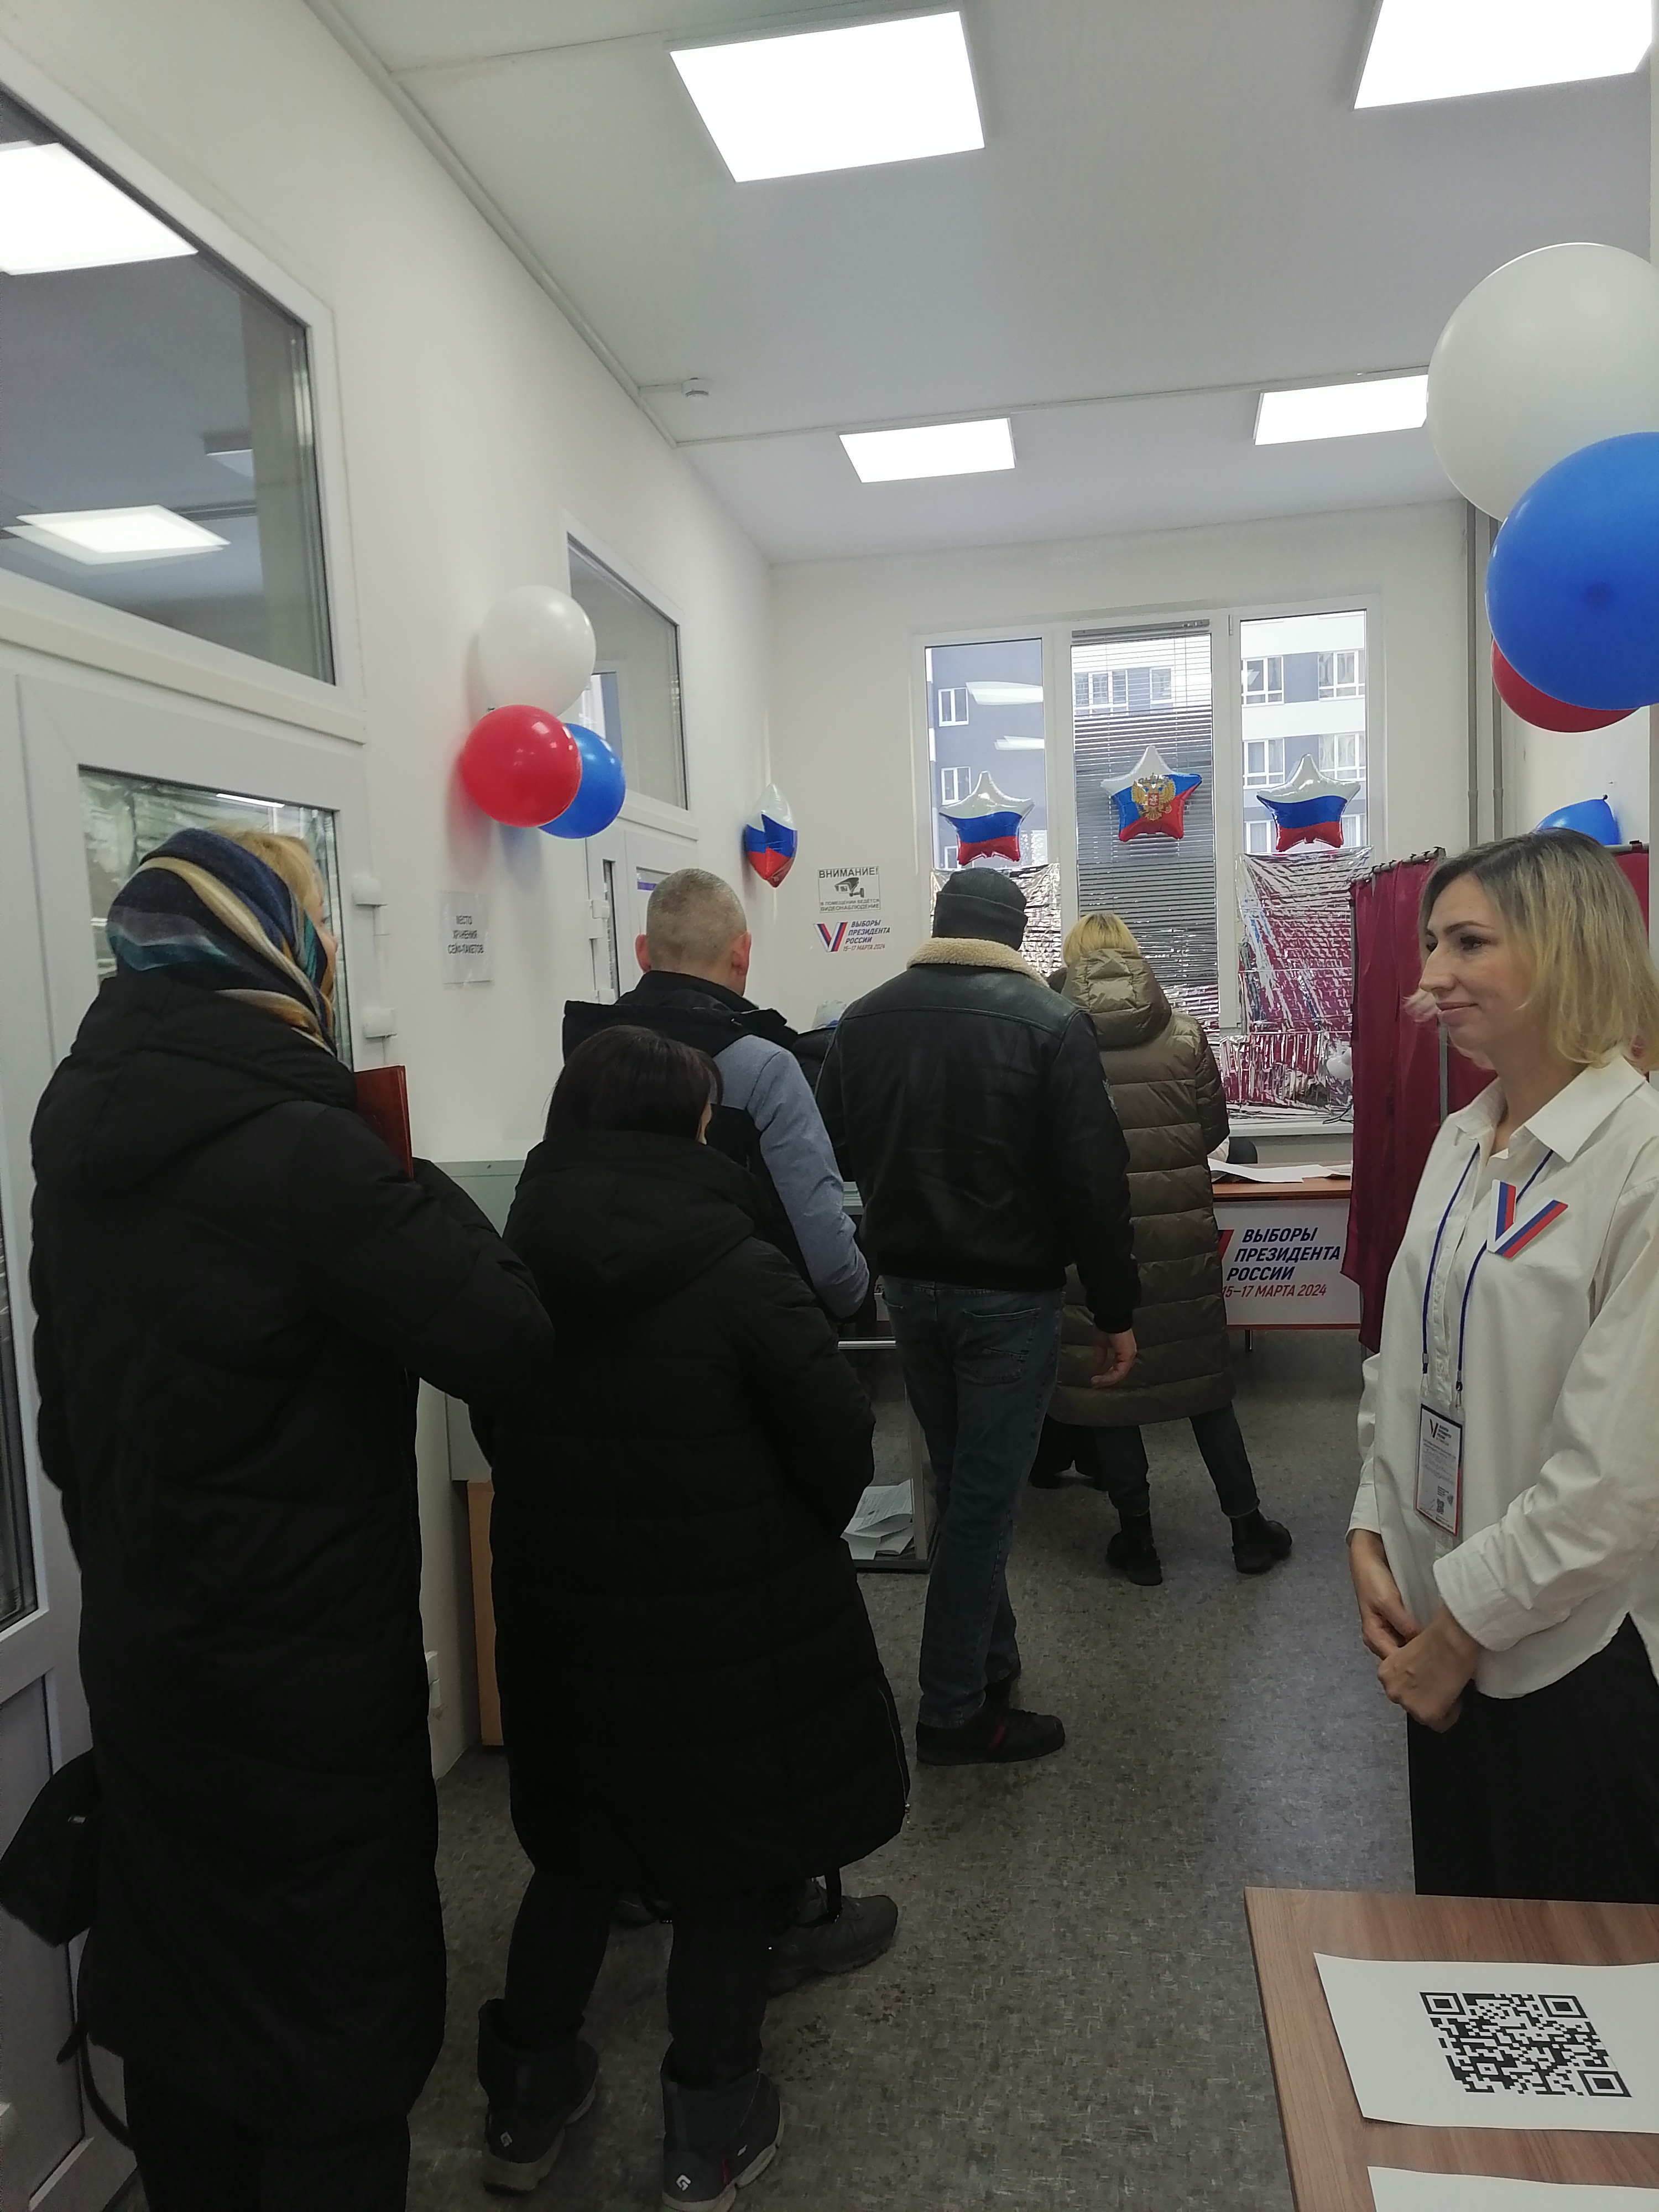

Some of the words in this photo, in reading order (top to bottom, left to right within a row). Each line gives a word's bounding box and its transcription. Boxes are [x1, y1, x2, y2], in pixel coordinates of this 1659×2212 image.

[818, 867, 878, 878] ВНИМАНИЕ!
[851, 920, 881, 928] ВЫБОРЫ
[848, 927, 890, 936] ПРЕЗИДЕНТА
[1242, 1227, 1318, 1243] ВЫБОРЫ
[1234, 1246, 1341, 1263] ПРЕЗИДЕНТА
[1226, 1266, 1296, 1281] РОССИИ
[1254, 1284, 1295, 1297] МАРТА
[1297, 1284, 1327, 1297] 2024
